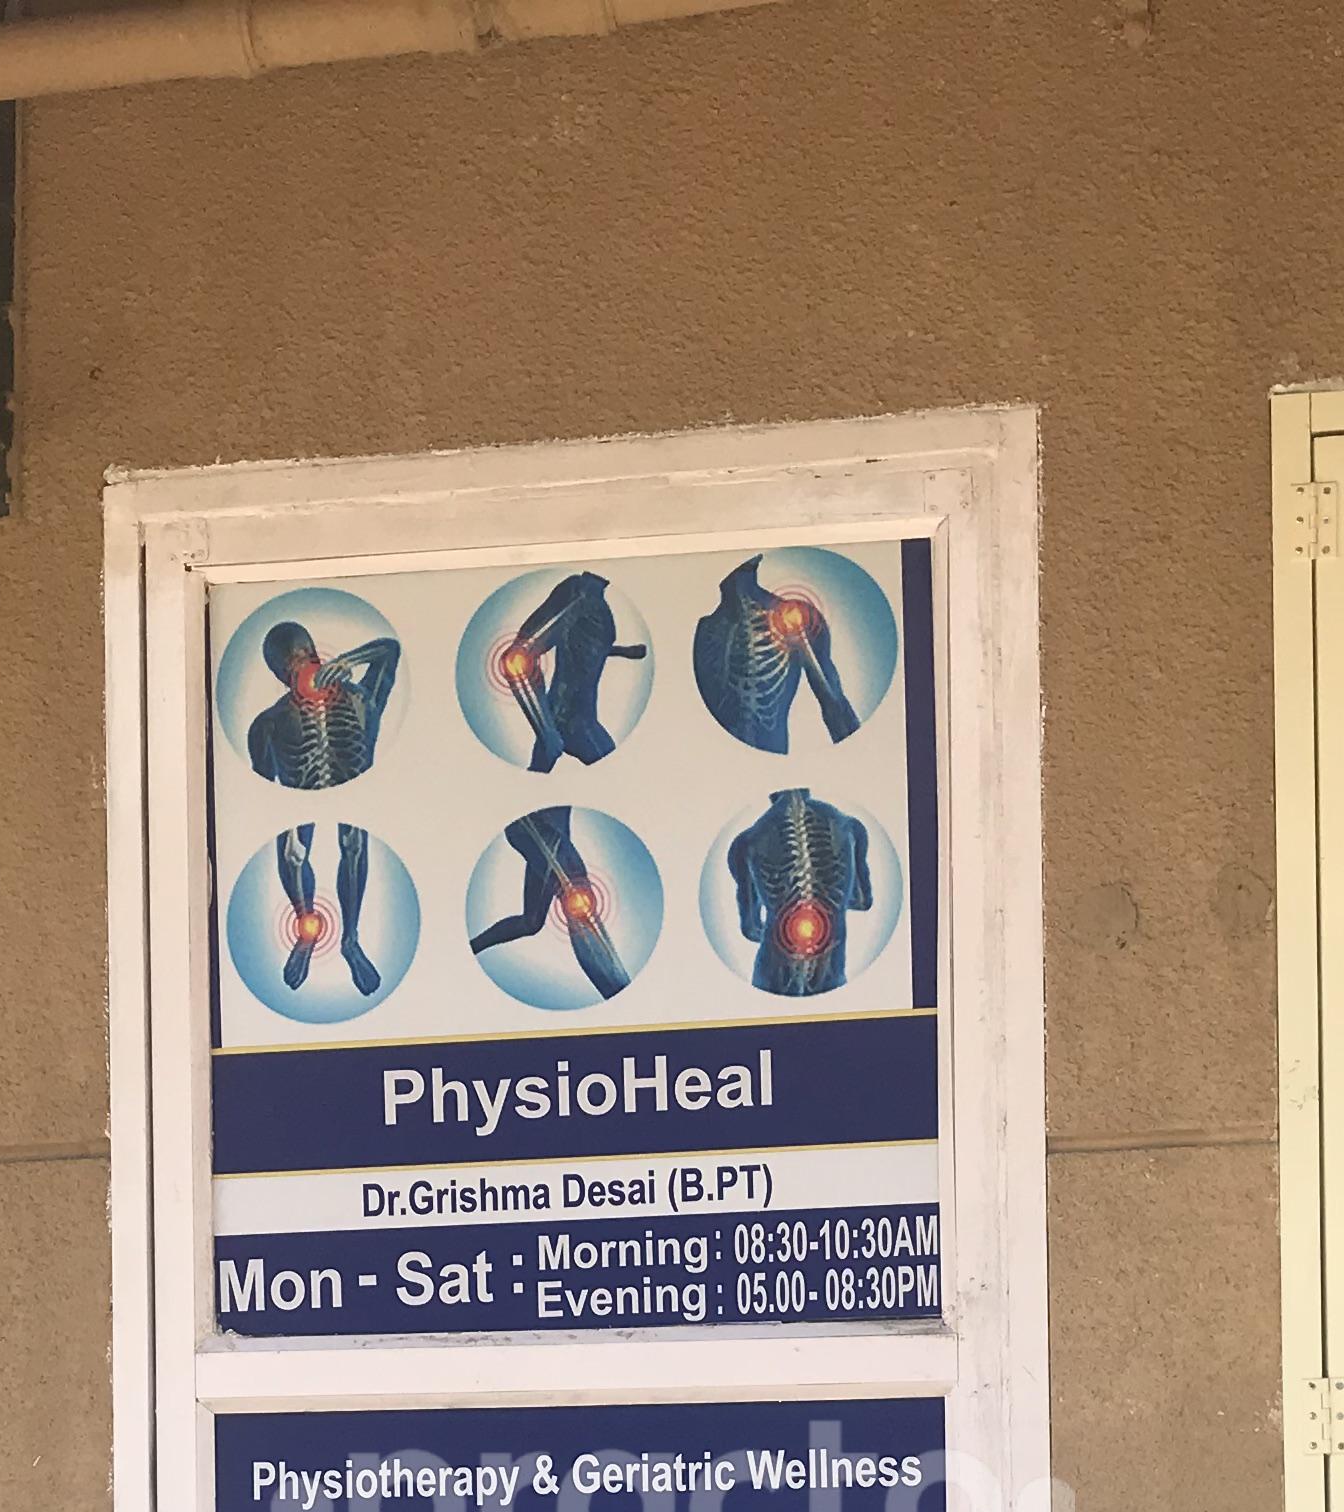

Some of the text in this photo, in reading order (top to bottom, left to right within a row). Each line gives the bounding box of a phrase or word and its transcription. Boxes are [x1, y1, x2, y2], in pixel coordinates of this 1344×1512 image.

[382, 1049, 774, 1136] PhysioHeal
[363, 1165, 774, 1218] Dr.Grishma Desai (B.PT)
[219, 1259, 343, 1313] Mon
[396, 1252, 493, 1306] Sat
[253, 1449, 922, 1510] Physiotherapy & Geriatric Wellness
